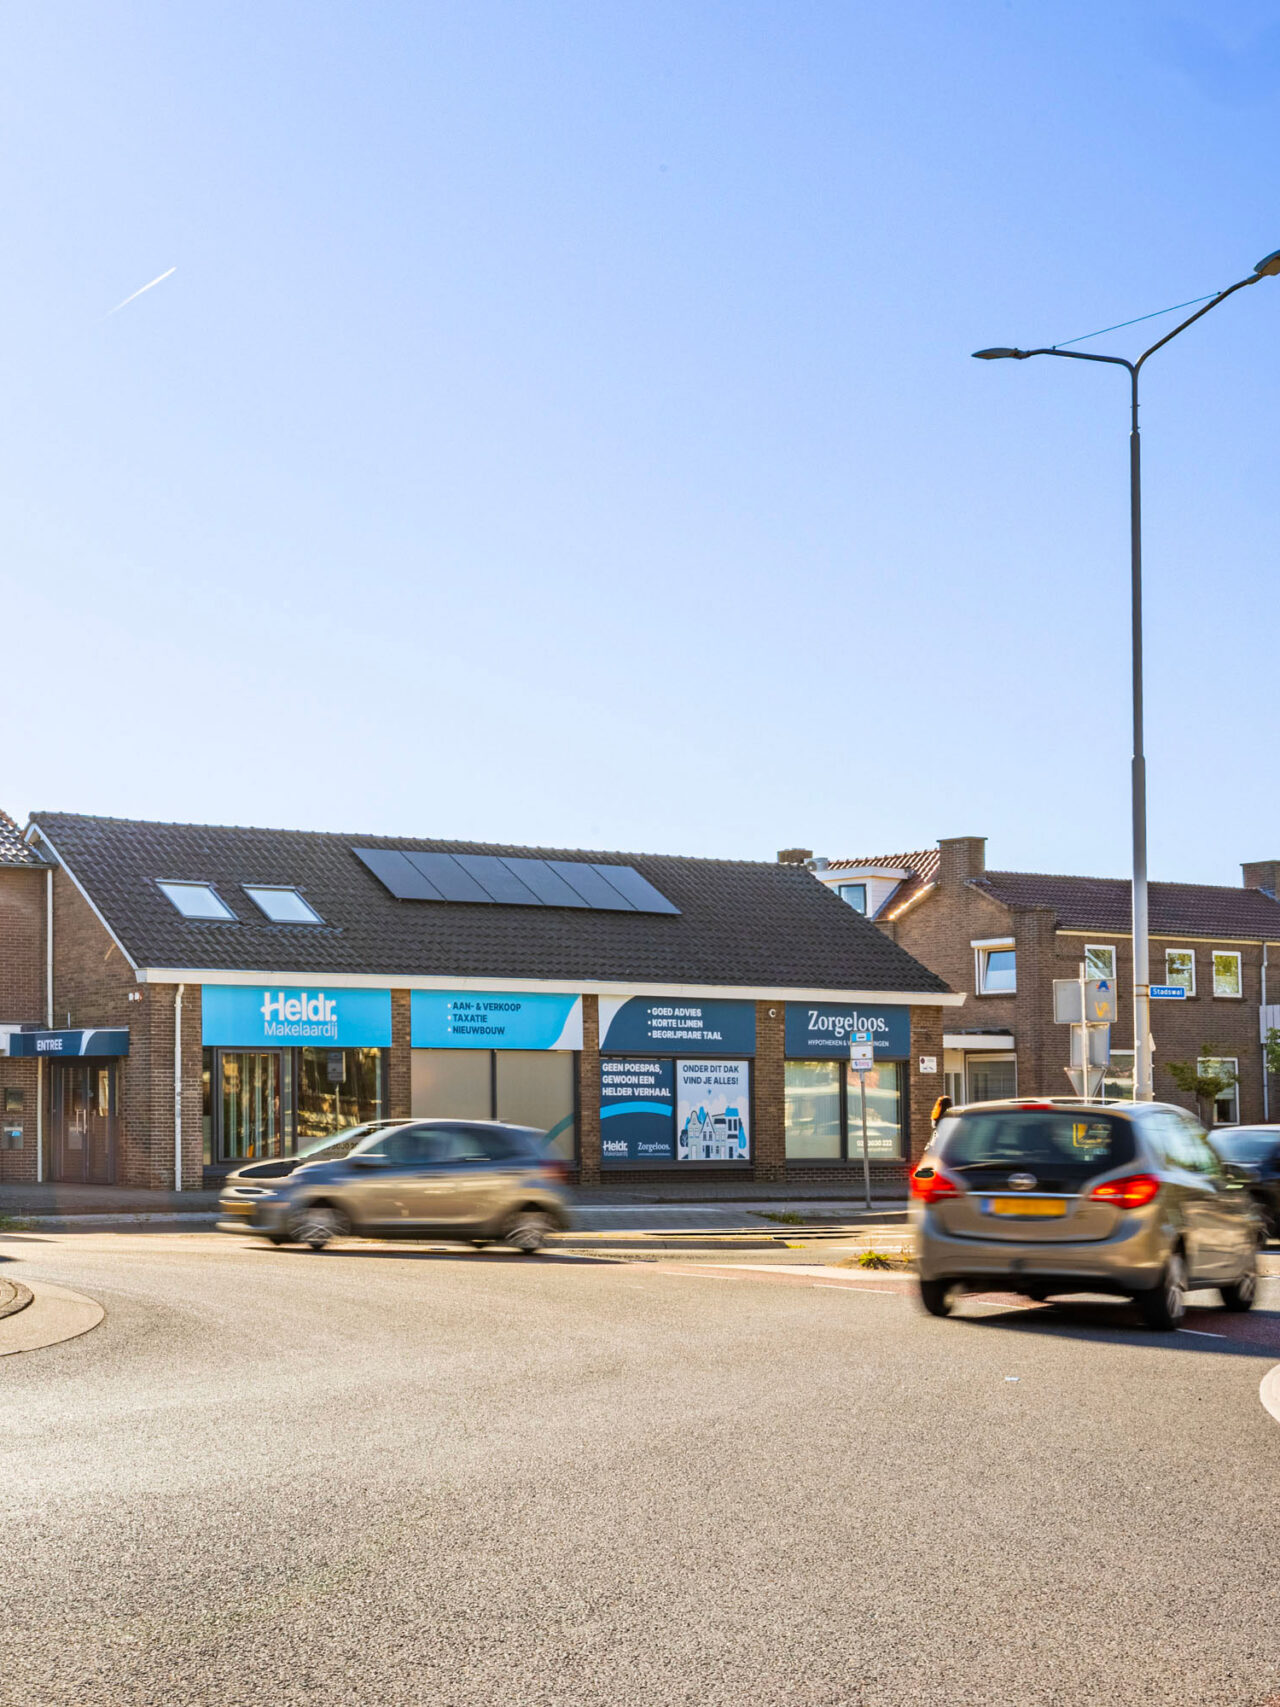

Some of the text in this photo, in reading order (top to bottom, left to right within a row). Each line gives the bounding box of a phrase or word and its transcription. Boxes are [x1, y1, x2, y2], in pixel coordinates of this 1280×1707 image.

[260, 992, 337, 1022] Heldr.
[452, 1002, 522, 1012] AAN- & VERKOOP
[652, 1007, 702, 1017] GOED ADVIES
[452, 1014, 488, 1023] TAXATIE
[652, 1019, 703, 1028] KORTE LIJNEN
[808, 1010, 889, 1037] Zorgeloos.
[264, 1022, 338, 1040] Makelaardij
[452, 1025, 505, 1035] NIEUWBOUW
[652, 1030, 723, 1040] BEGRIJPBARE TAAL
[36, 1039, 63, 1051] ENTREE
[808, 1039, 842, 1047] HYPOTHEKEN
[602, 1063, 663, 1074] GEEN POESPAS,
[683, 1065, 739, 1073] ONDER DIT DAK
[602, 1075, 655, 1084] GEWOON EEN
[683, 1076, 739, 1085] VIND JE ALLES!
[602, 1087, 671, 1097] HELDER VERHAAL
[637, 1141, 671, 1152] Zorgeloos.
